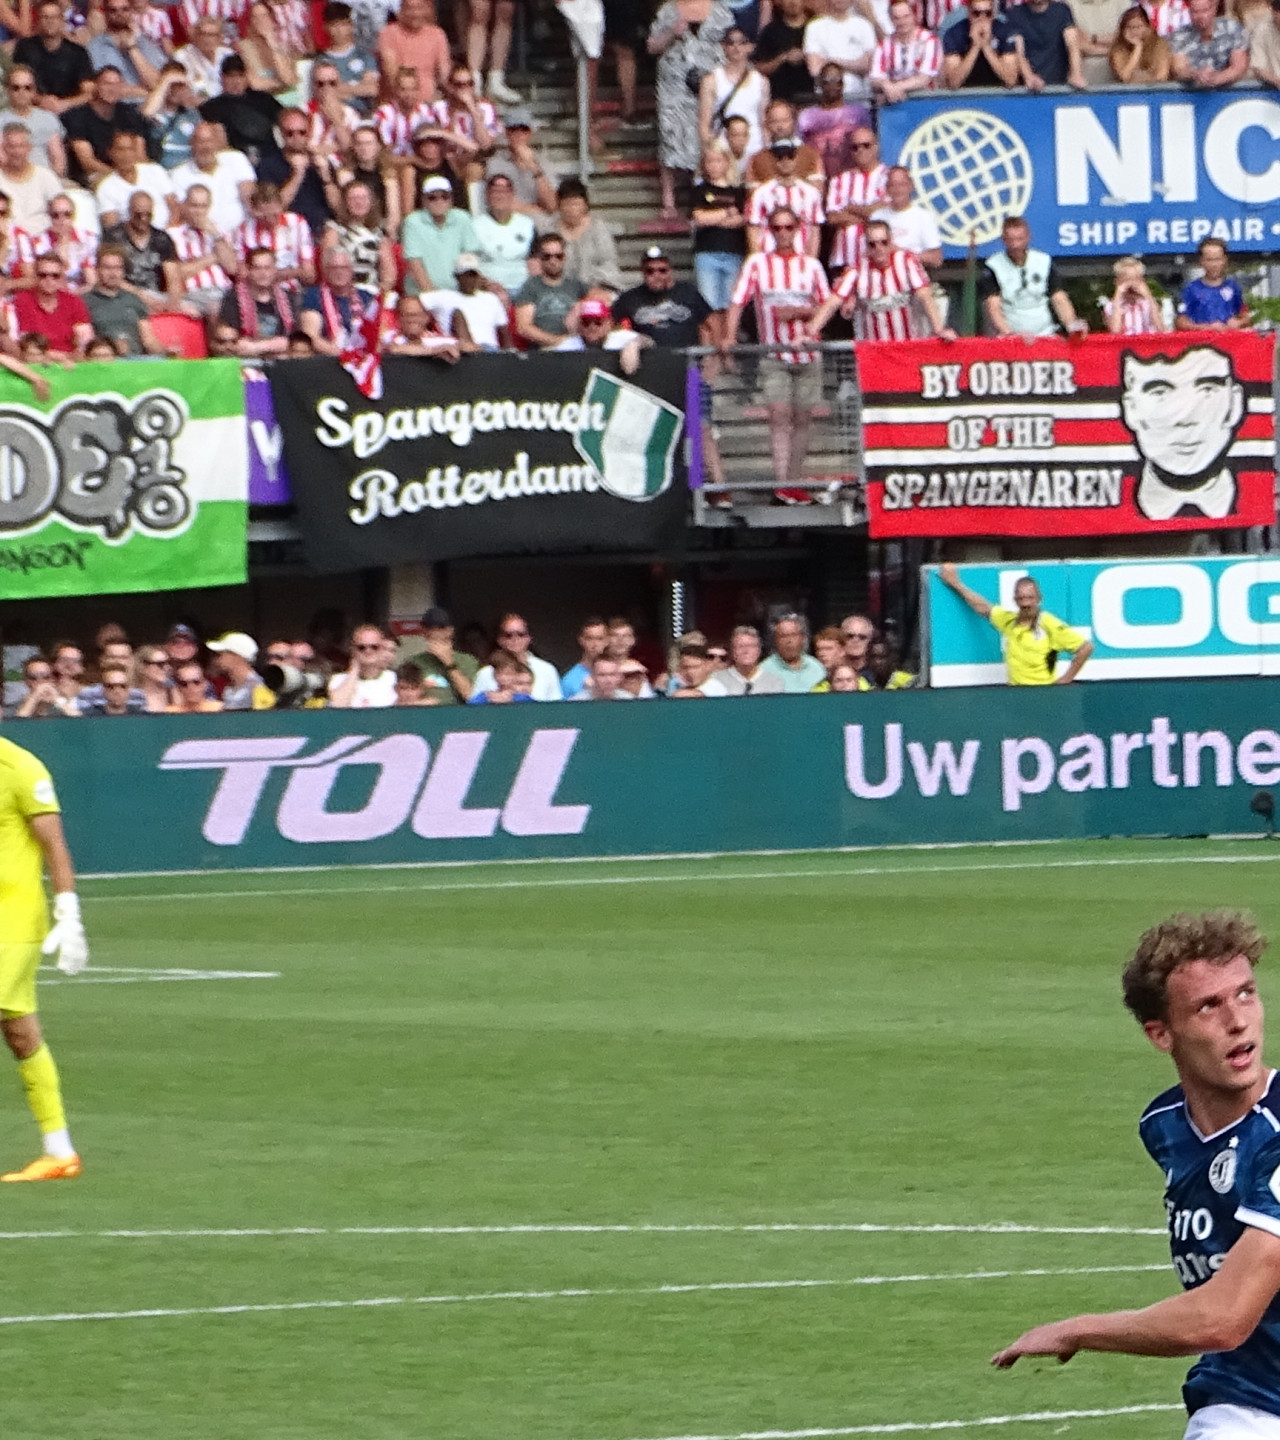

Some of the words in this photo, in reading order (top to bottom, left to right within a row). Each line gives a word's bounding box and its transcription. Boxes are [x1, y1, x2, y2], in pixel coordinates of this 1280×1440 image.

[1058, 220, 1137, 246] SHIP
[1155, 217, 1264, 243] REPAIR
[920, 364, 962, 398] BY
[969, 361, 1077, 396] ORDER
[315, 397, 606, 459] Spangenaren
[948, 416, 986, 449] OF
[991, 414, 1055, 448] THE
[349, 452, 599, 525] Rotterdam
[883, 469, 1122, 510] SPANGENAREN
[158, 727, 591, 845] TOLL
[843, 722, 981, 799] Uw
